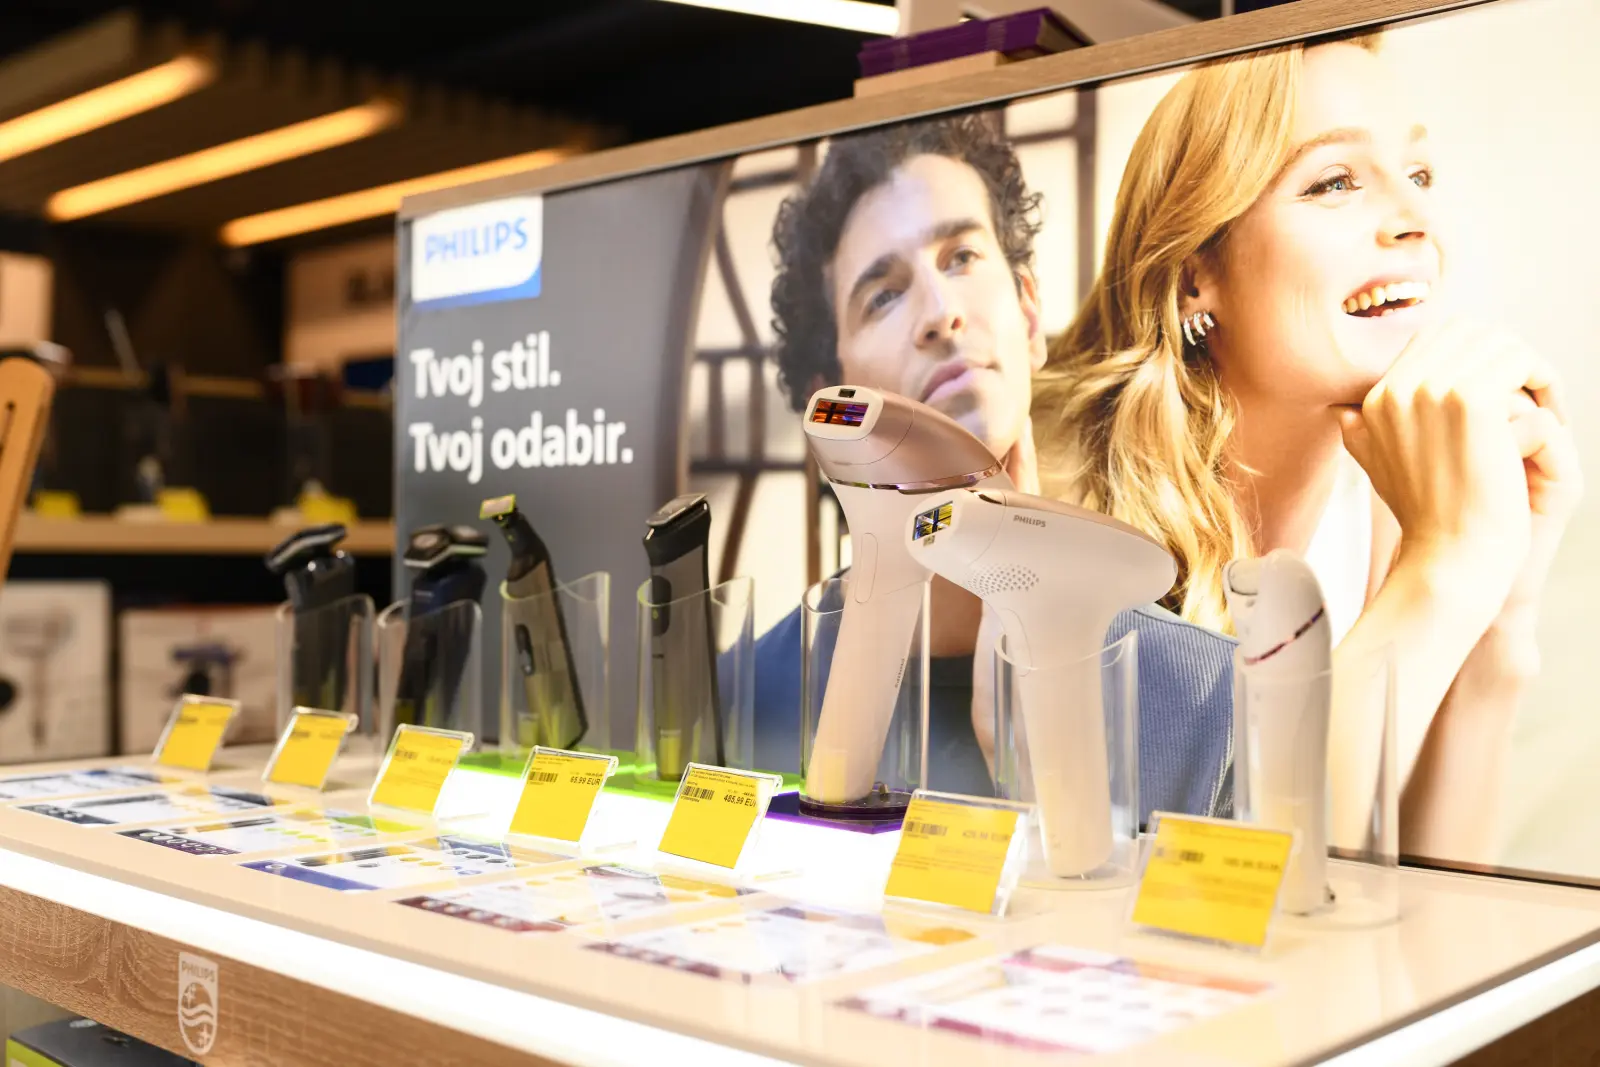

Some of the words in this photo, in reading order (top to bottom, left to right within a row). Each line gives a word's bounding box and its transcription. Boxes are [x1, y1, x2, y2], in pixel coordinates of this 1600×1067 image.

[425, 217, 528, 264] PHILIPS
[409, 338, 484, 408] Tvoj
[491, 330, 561, 392] stil.
[409, 415, 484, 484] Tvoj
[490, 407, 634, 470] odabir.
[1013, 514, 1047, 528] PHILIPS
[586, 777, 601, 786] EUR
[181, 960, 215, 983] PHILIPS
